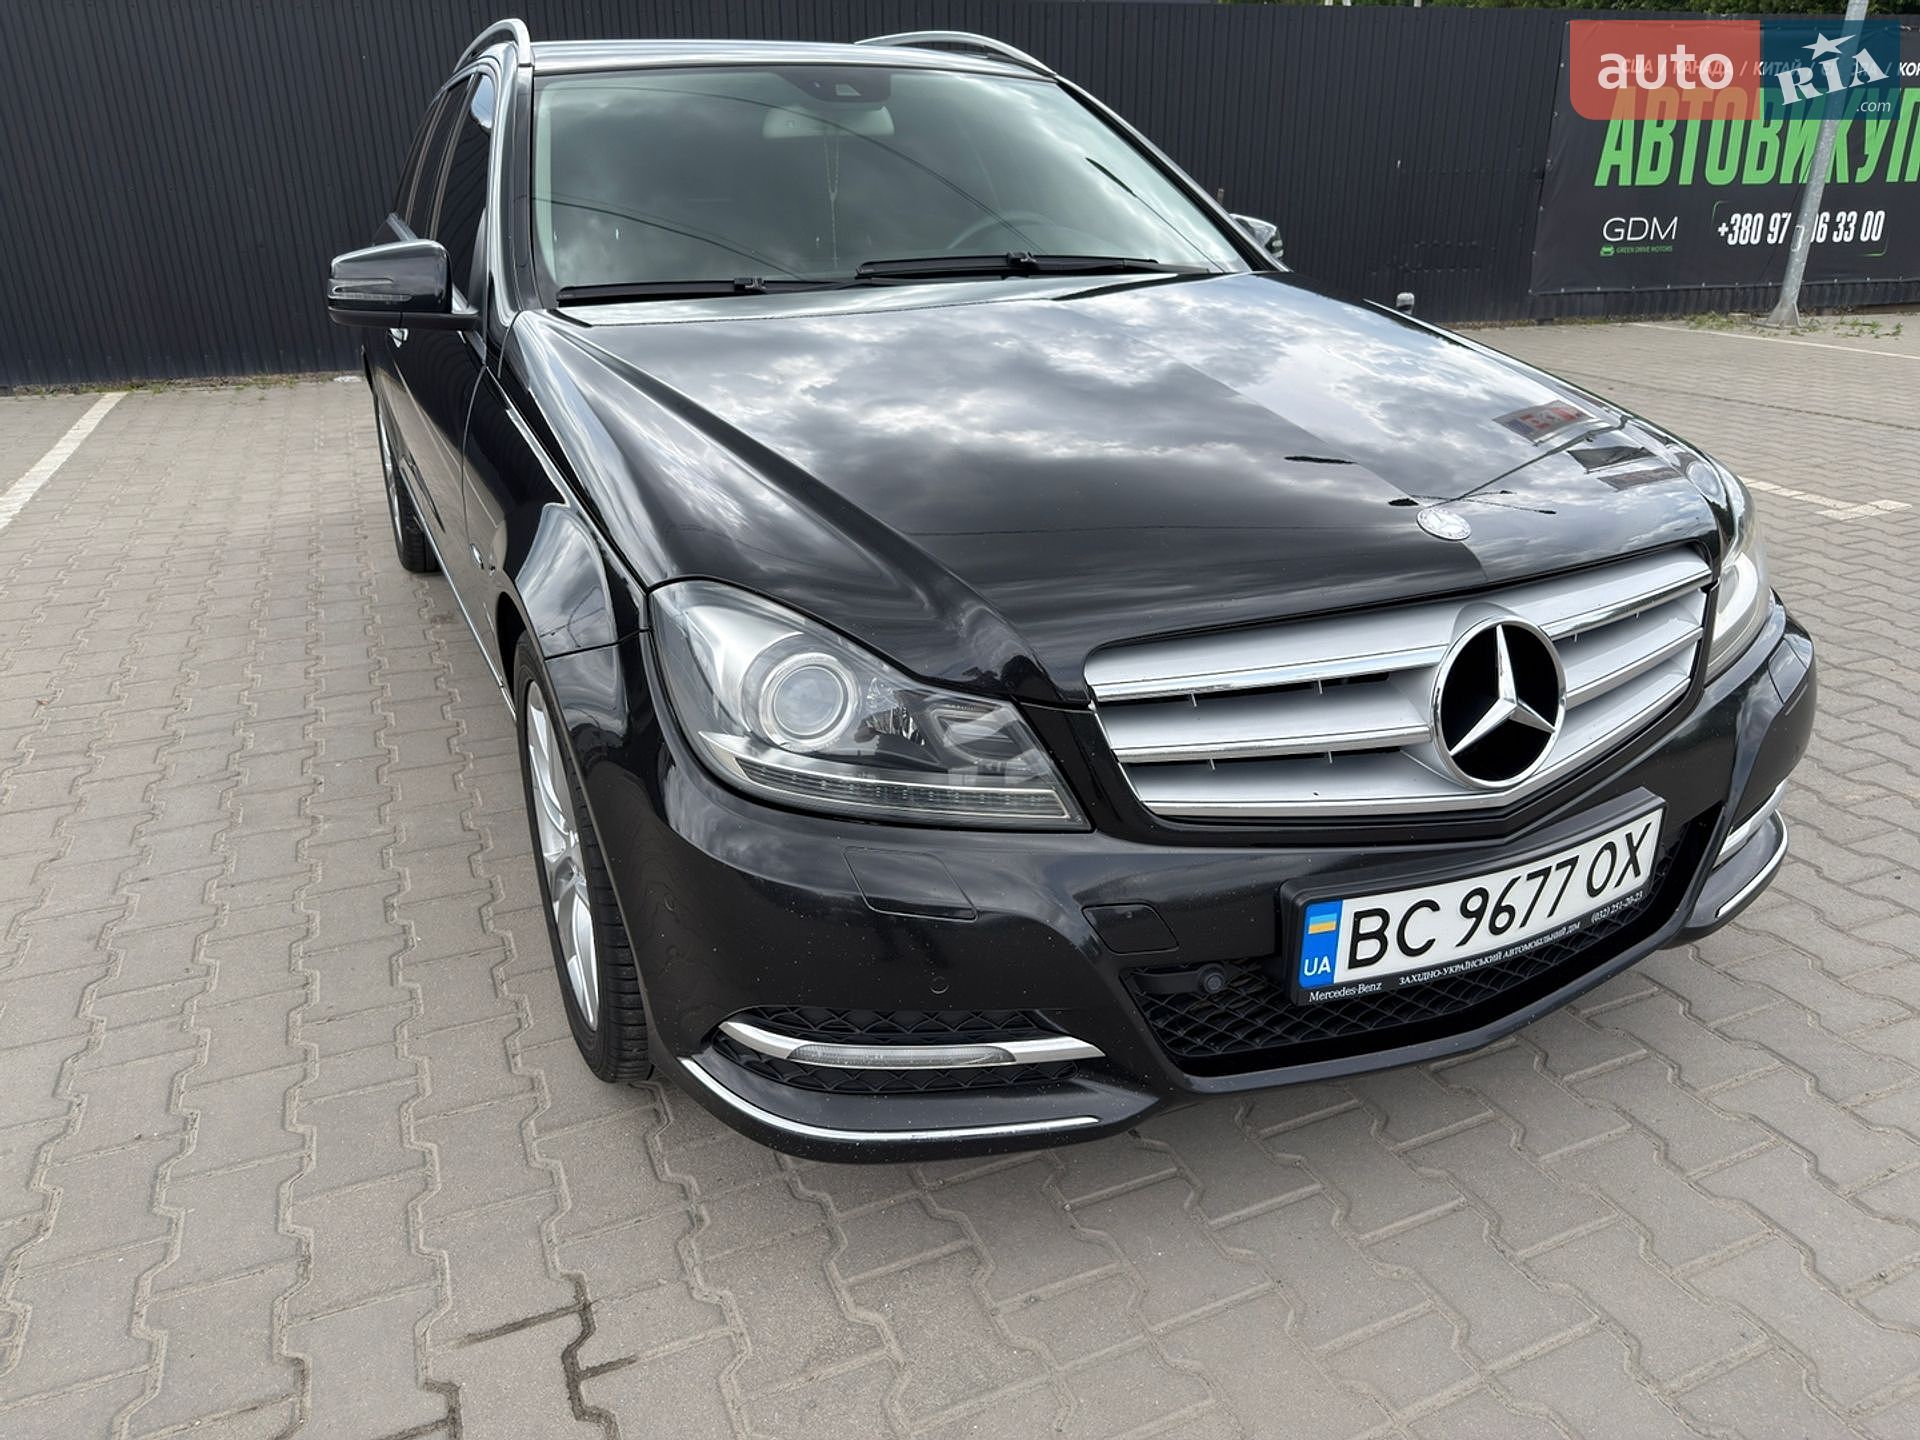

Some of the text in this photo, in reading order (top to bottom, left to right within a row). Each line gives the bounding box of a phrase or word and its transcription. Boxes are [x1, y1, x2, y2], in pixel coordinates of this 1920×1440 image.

[1594, 86, 1920, 186] АВТОВИКУП
[1602, 216, 1679, 242] GDM
[1718, 213, 1764, 246] +380
[1767, 212, 1792, 244] 97
[1832, 211, 1858, 243] 33
[1860, 210, 1885, 242] 00
[1347, 821, 1652, 970] BC 9677 OX
[1304, 955, 1332, 976] UA
